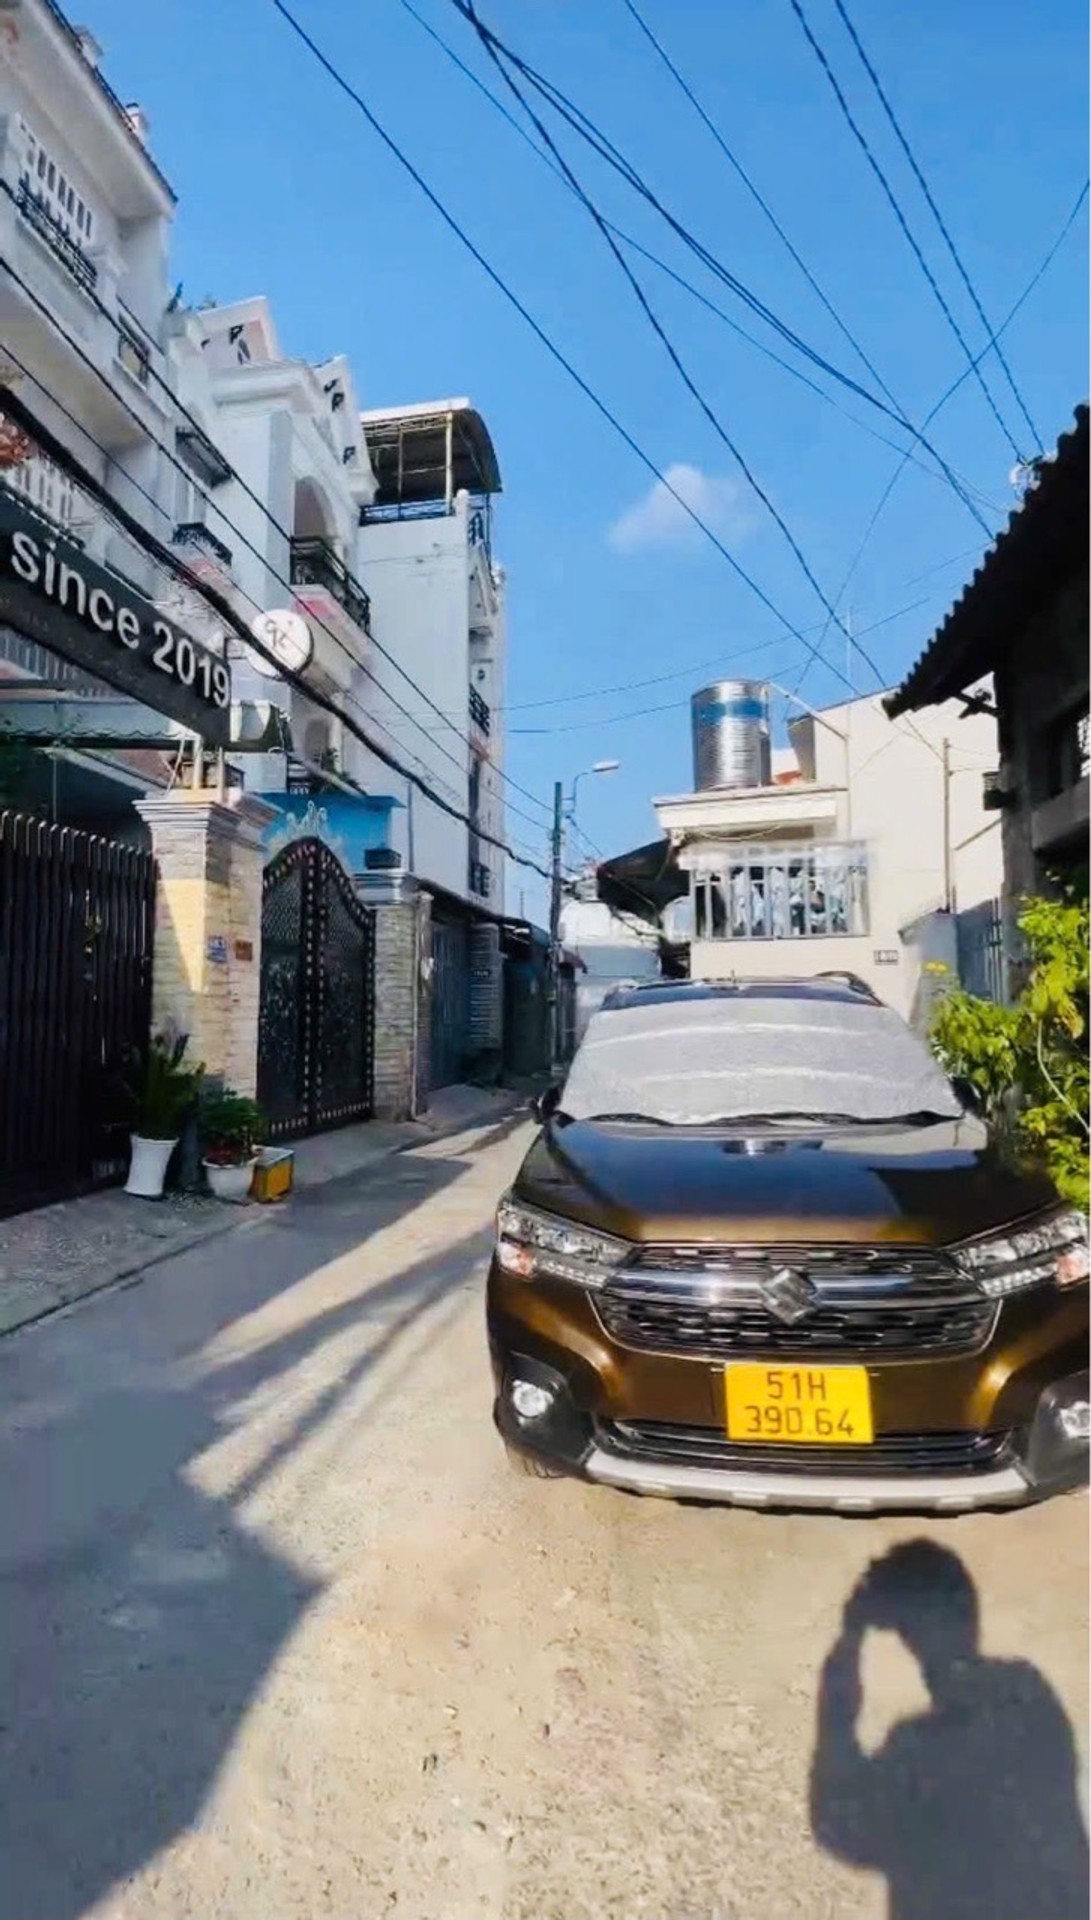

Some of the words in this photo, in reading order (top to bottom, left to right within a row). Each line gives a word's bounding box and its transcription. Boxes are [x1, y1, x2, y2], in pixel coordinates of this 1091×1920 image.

[10, 531, 140, 649] since
[152, 621, 229, 708] 2019
[766, 1370, 826, 1400] 51H
